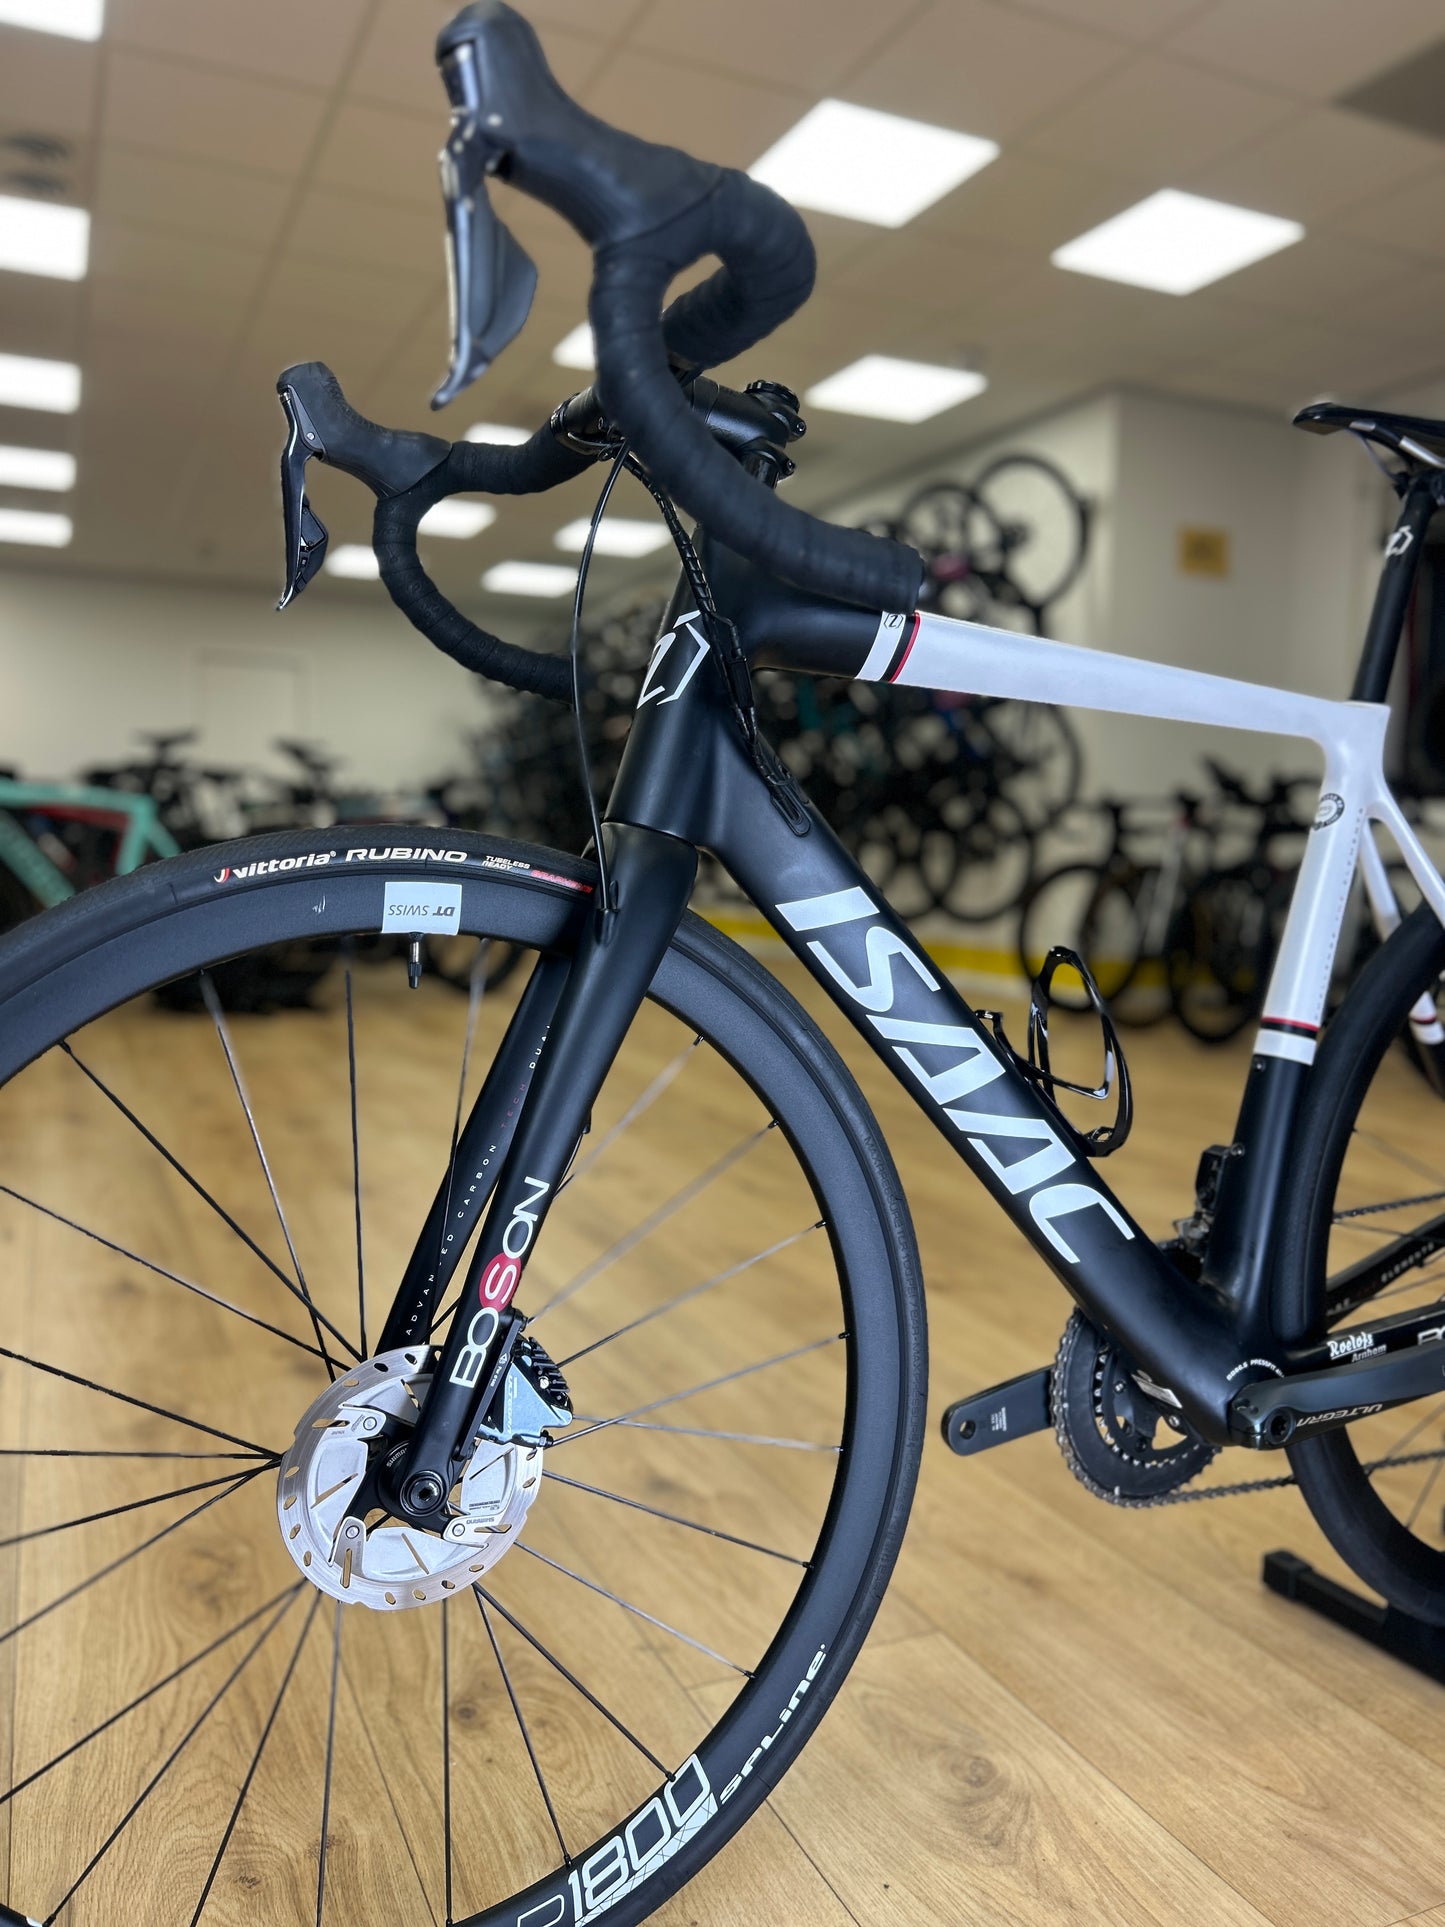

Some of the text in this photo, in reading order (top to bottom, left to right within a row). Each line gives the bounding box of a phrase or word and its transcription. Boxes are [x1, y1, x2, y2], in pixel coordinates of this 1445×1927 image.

[345, 847, 468, 863] RUBINO
[485, 855, 531, 869] TUBELESS
[388, 904, 456, 917] DT SWISS
[774, 886, 1136, 1264] ISAAC
[405, 1233, 454, 1336] ADVANED
[457, 1144, 497, 1219] CARBON
[449, 1176, 551, 1388] BOSON
[1327, 1332, 1374, 1359] Roelofs
[1296, 1403, 1383, 1428] ULTEGRA
